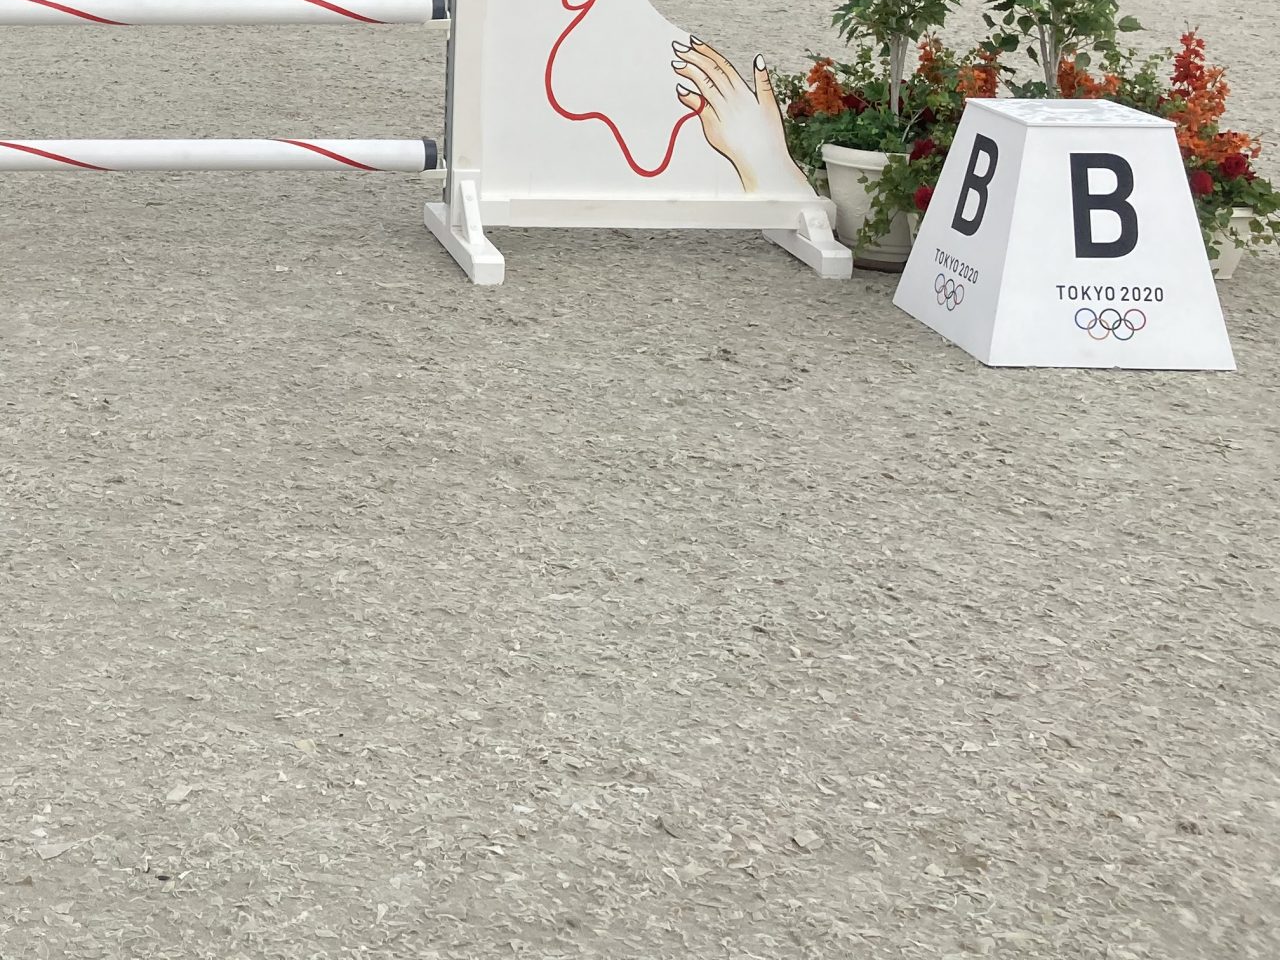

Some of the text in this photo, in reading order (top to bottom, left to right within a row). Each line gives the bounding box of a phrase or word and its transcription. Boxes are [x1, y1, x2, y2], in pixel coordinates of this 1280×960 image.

[951, 133, 999, 236] B
[1070, 153, 1139, 258] B
[934, 248, 979, 284] TOKYO 2020
[1055, 285, 1164, 302] TOKYO 2020
